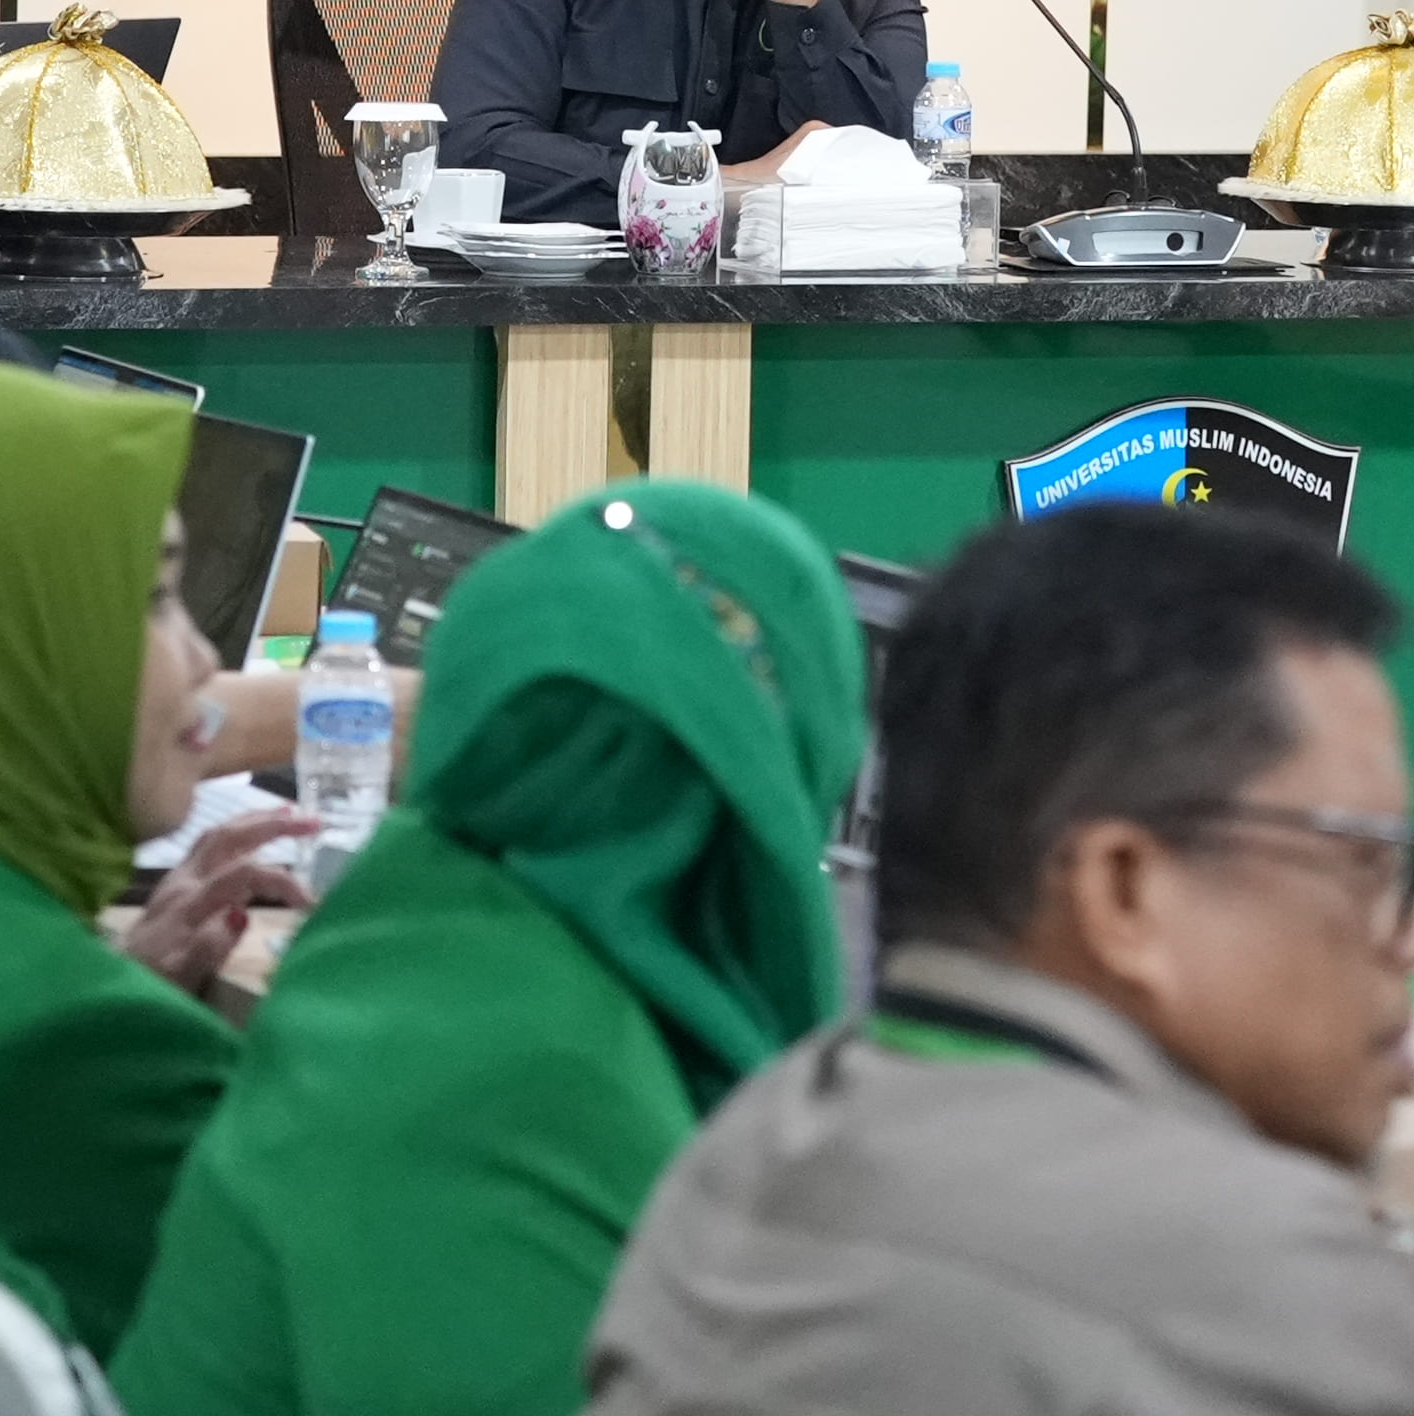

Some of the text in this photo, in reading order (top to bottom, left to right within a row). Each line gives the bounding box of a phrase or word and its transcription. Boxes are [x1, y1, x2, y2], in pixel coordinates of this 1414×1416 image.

[1036, 428, 1332, 509] UNIVERSITAS MUSLIM INDONESIA
